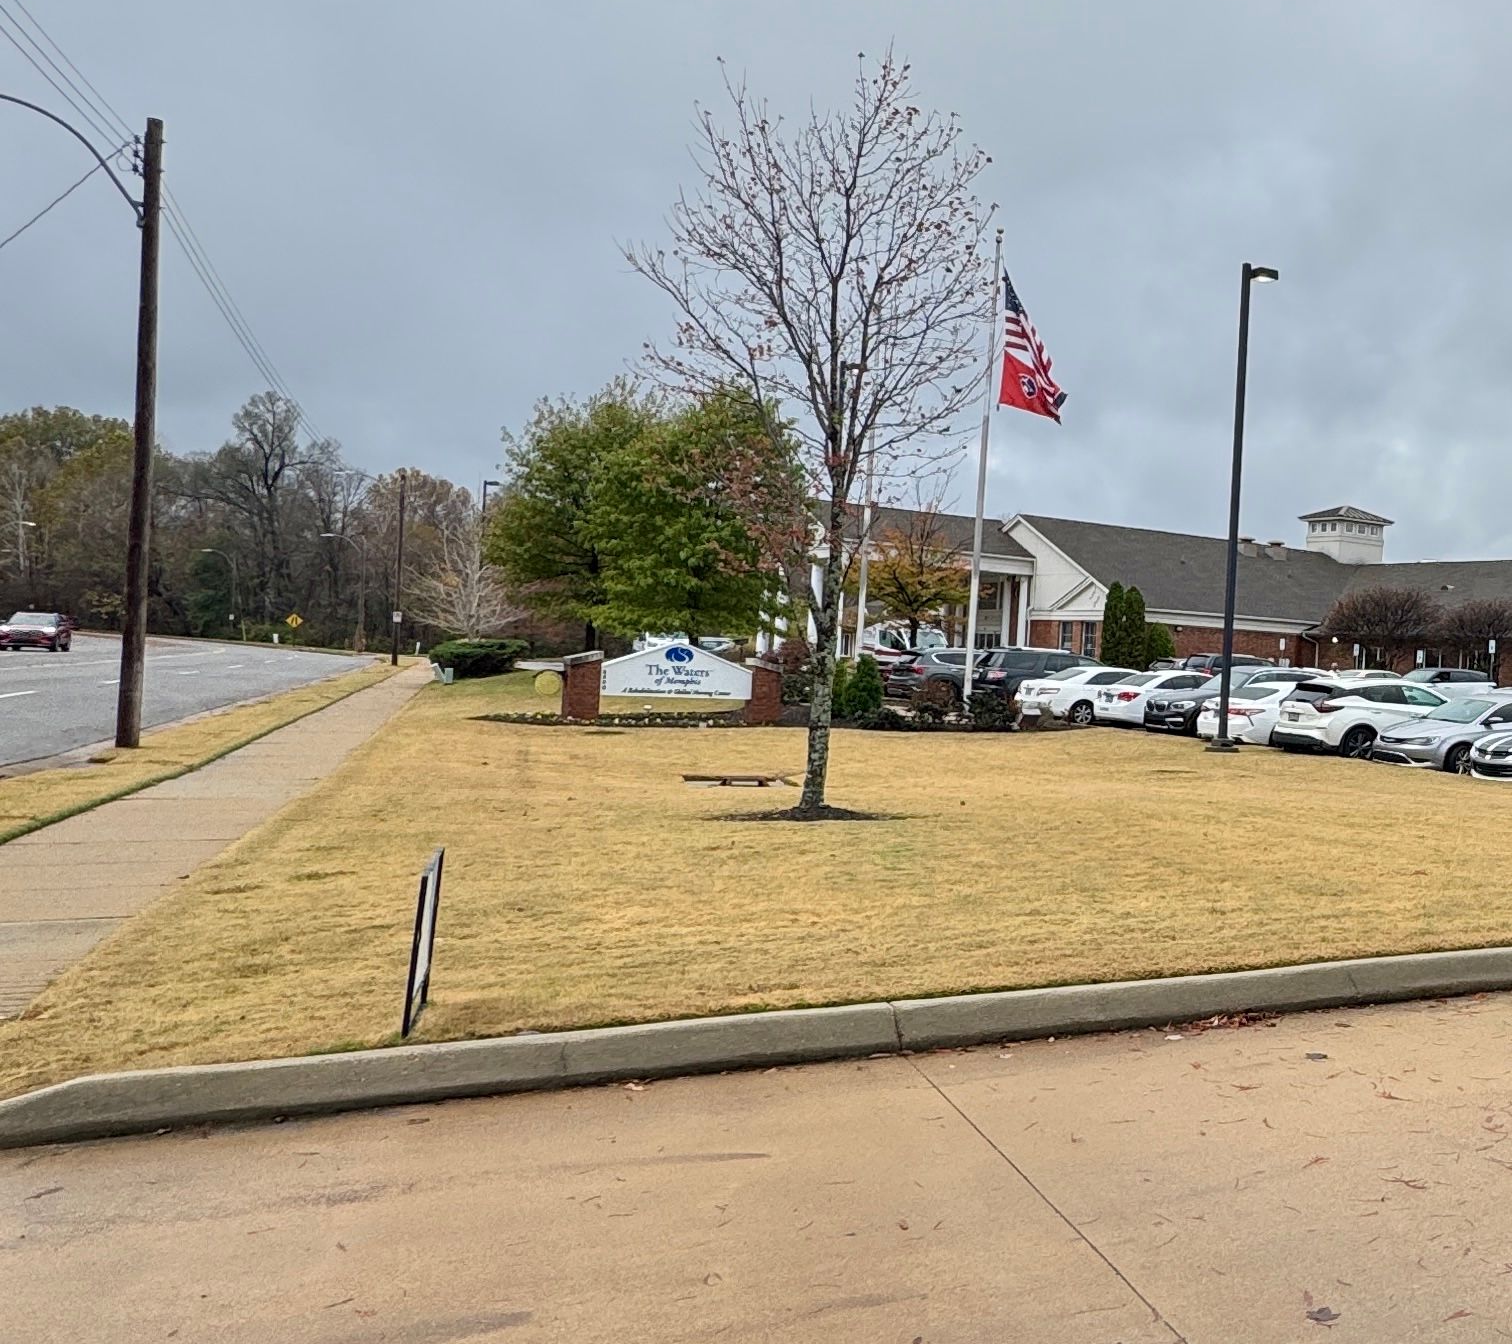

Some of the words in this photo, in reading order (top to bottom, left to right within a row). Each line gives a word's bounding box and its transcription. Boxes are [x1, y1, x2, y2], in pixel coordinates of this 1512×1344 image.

[645, 664, 670, 676] The
[671, 665, 710, 677] Waters
[654, 675, 665, 686] of
